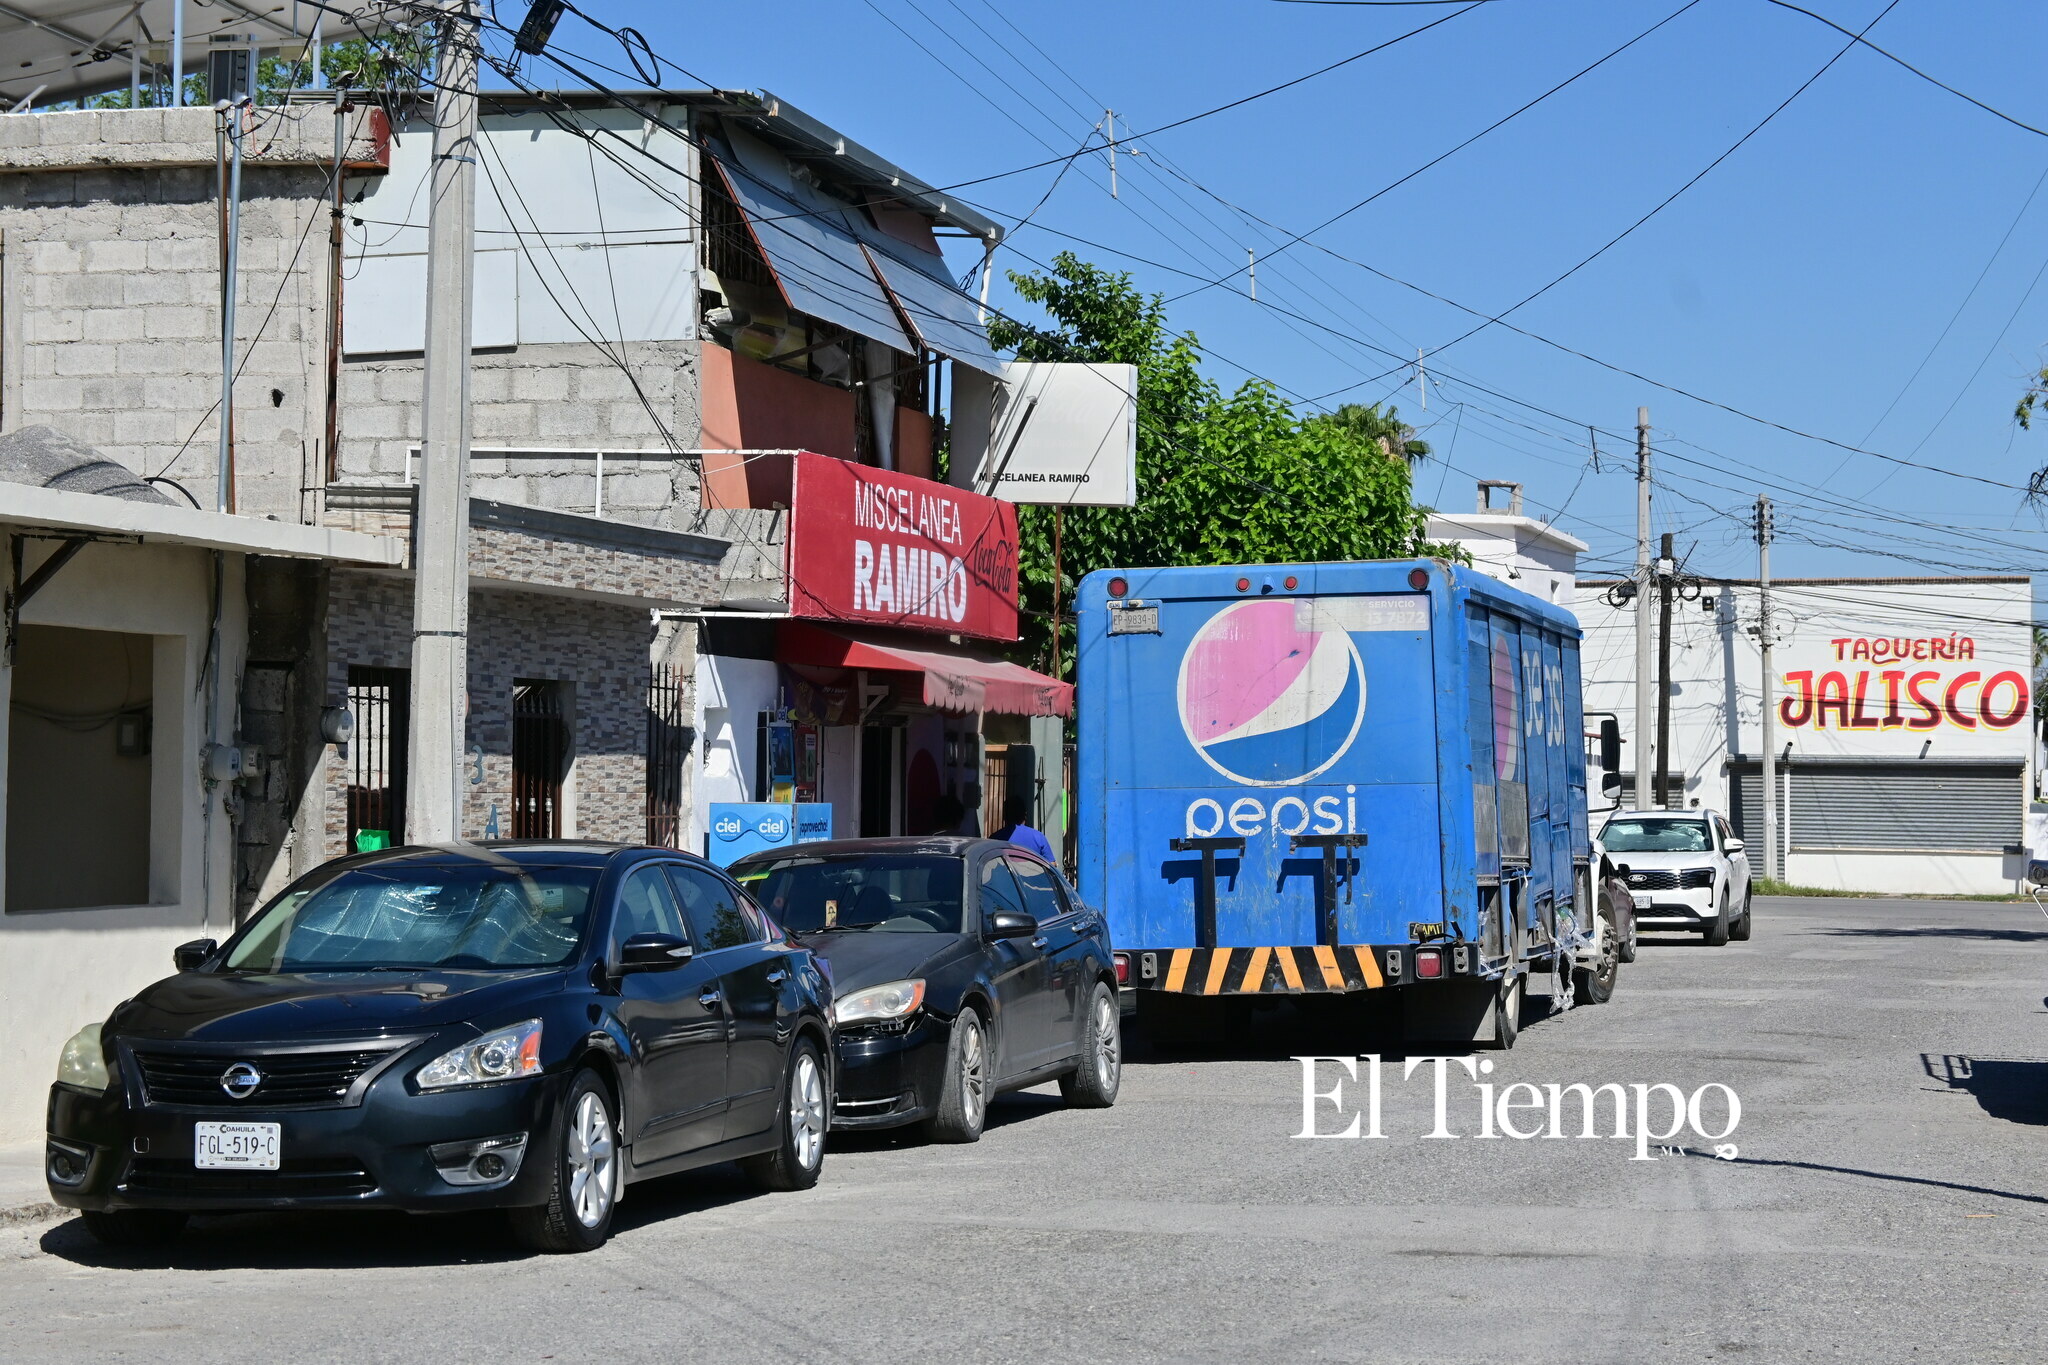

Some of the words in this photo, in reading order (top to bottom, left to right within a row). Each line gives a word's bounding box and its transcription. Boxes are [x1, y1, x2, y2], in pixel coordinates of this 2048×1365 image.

[979, 472, 1046, 482] MCELANEA
[1048, 473, 1091, 483] RAMIRO
[855, 479, 962, 546] MISCELANEA
[853, 539, 968, 623] RAMIRO
[1368, 600, 1416, 609] SERVICIO
[1830, 632, 1975, 665] TAQUERÍA
[1778, 669, 2030, 732] JALISCO
[715, 817, 741, 833] ciel
[758, 817, 784, 834] ciel
[1185, 784, 1357, 848] pepsi
[199, 1135, 275, 1156] FGL-519-C
